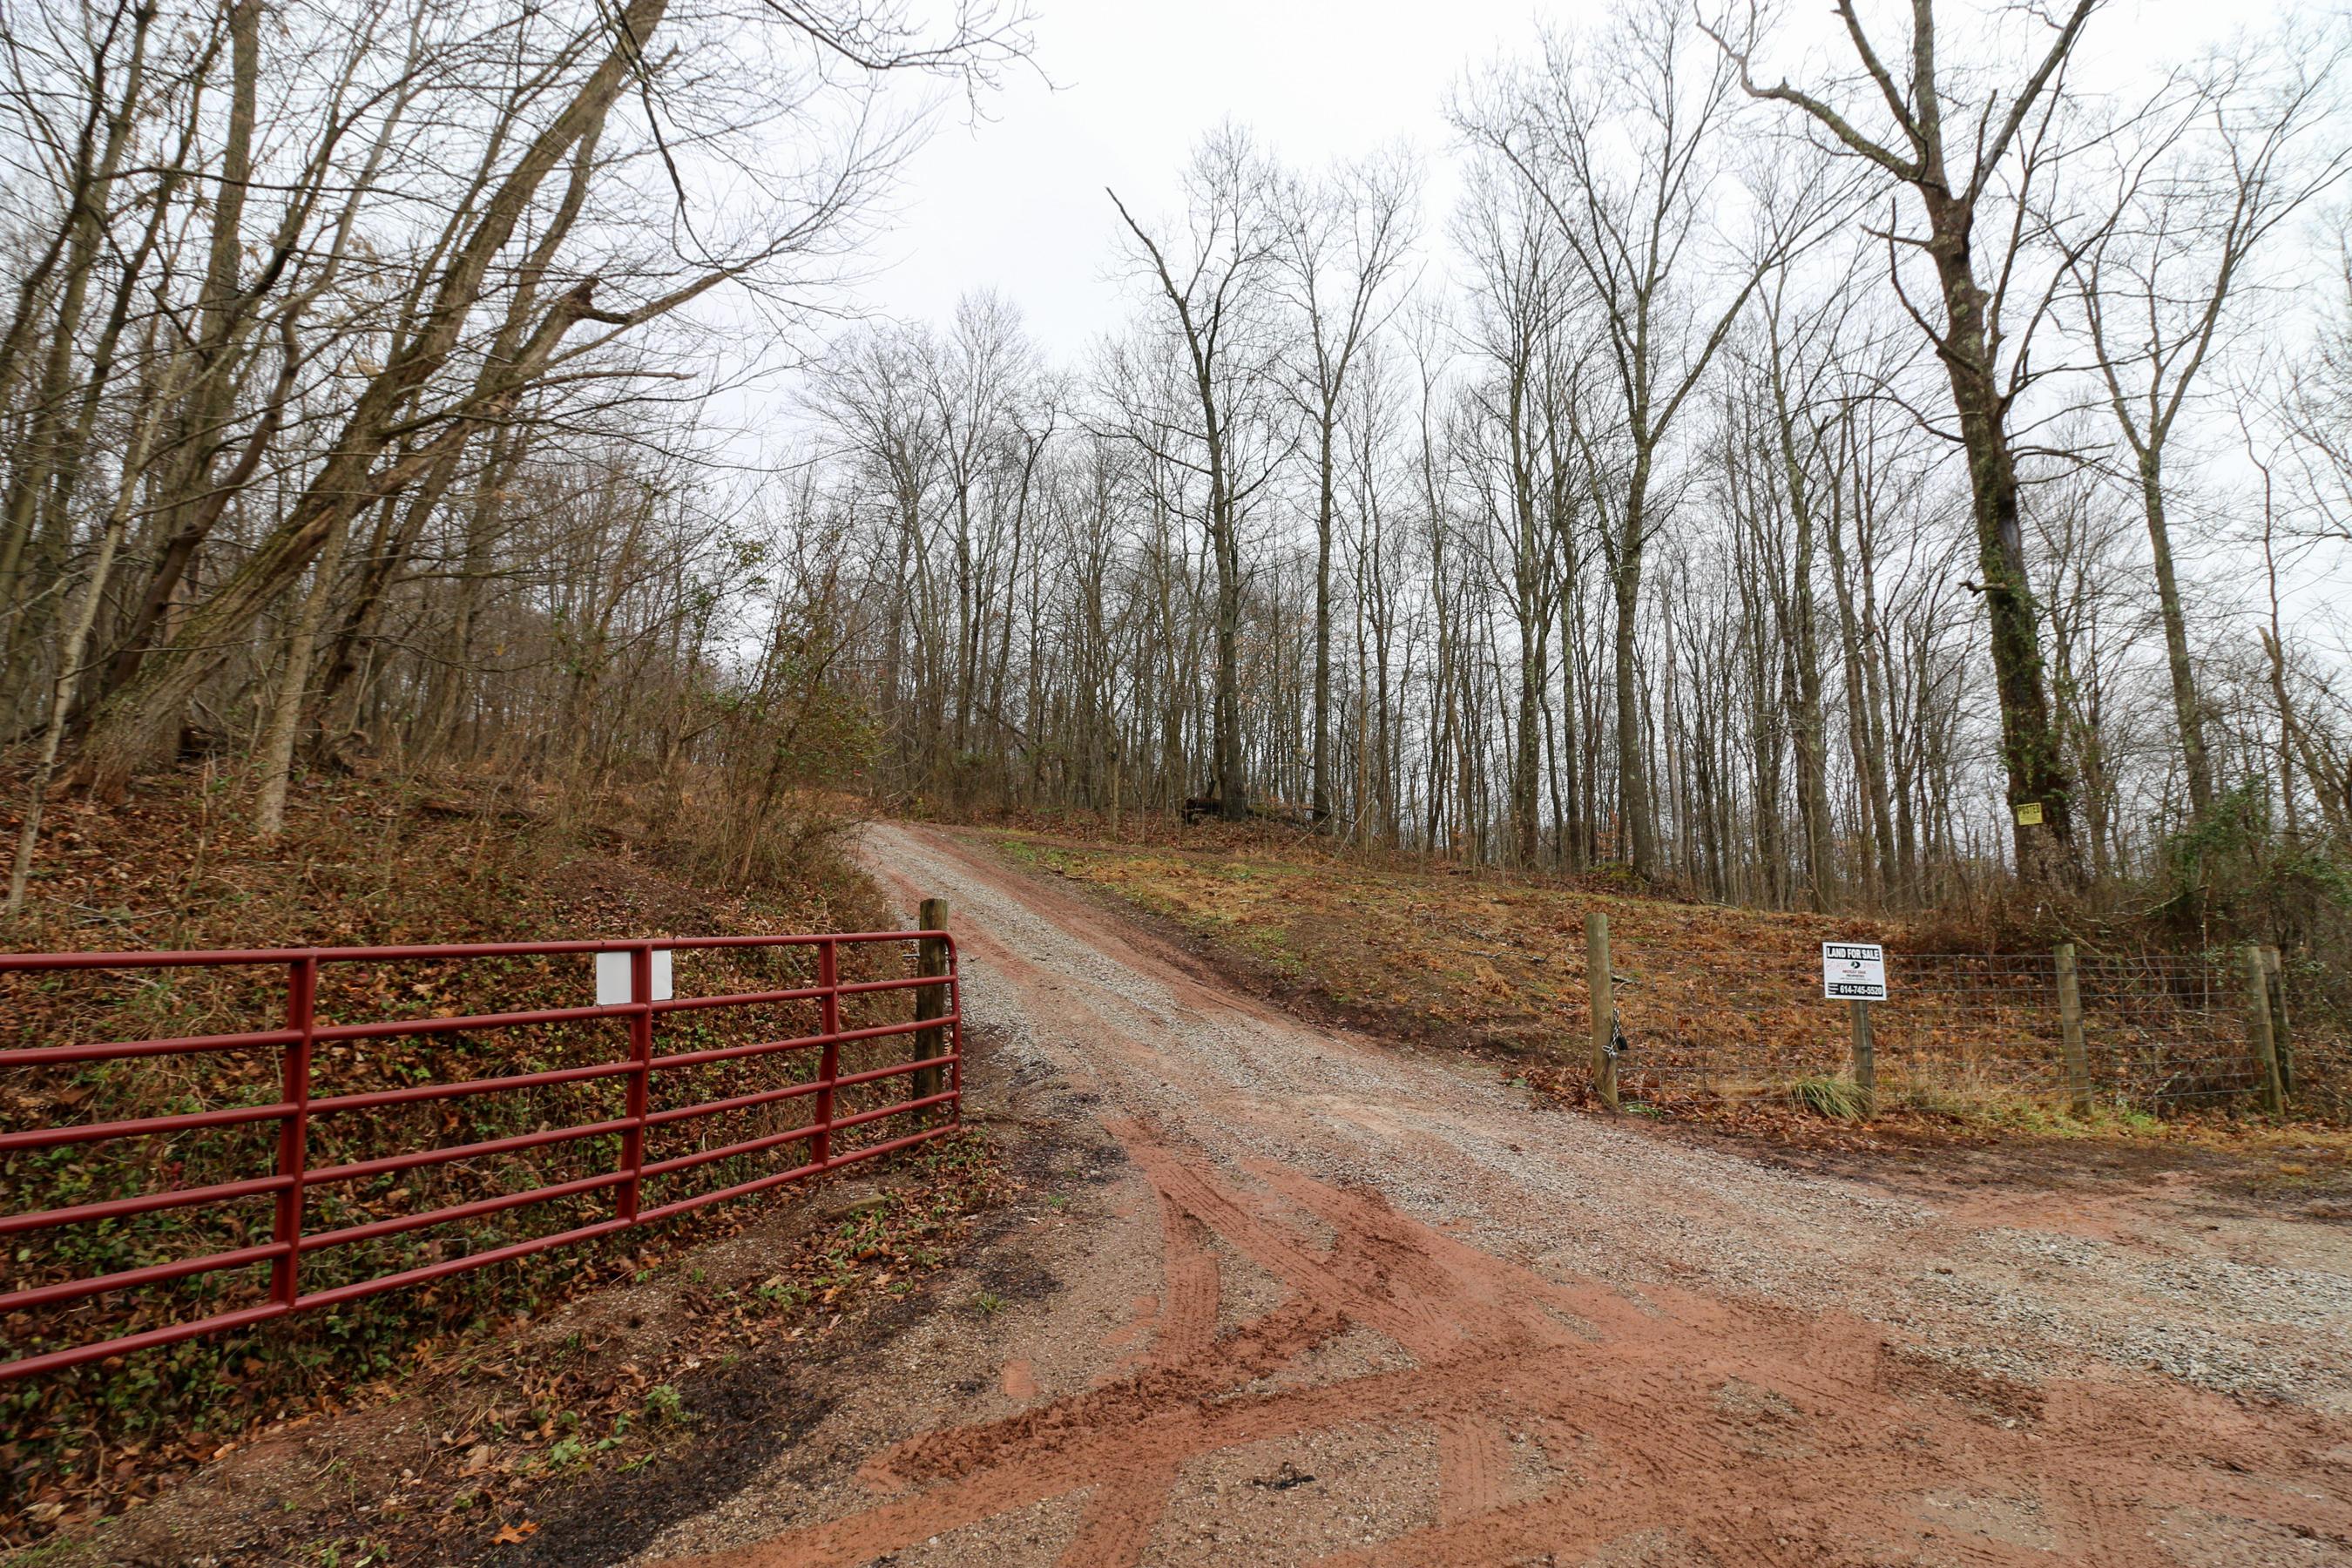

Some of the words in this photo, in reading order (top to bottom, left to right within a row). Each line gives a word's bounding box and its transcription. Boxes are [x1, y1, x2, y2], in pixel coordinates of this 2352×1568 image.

[1827, 947, 1846, 957] LAND
[1847, 948, 1862, 958] FOR
[1862, 949, 1879, 959] SALE
[1840, 985, 1882, 995] 614-745-5520
